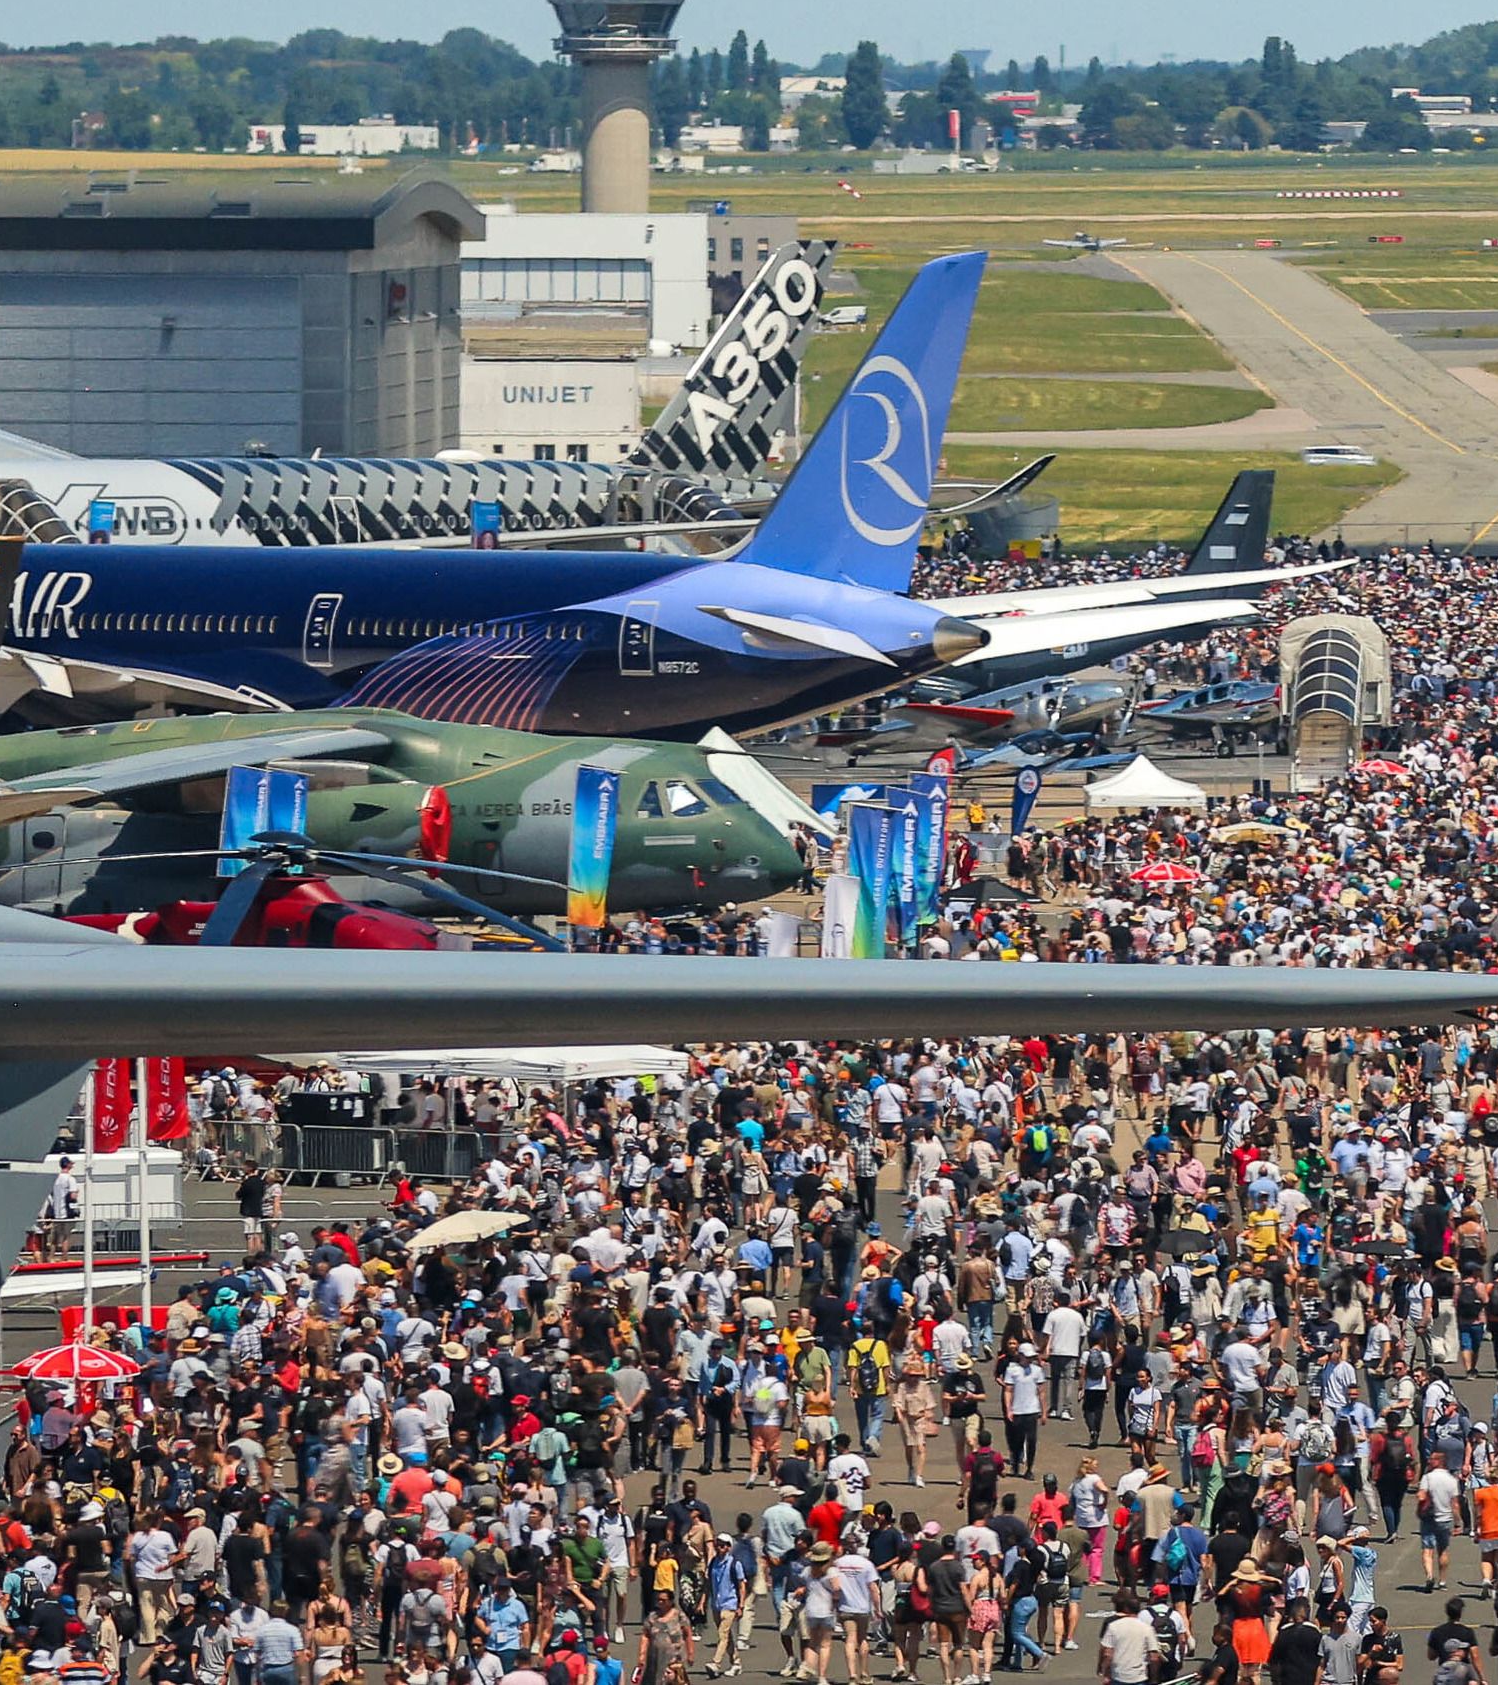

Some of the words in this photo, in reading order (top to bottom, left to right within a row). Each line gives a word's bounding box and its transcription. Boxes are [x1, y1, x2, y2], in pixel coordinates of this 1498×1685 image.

[503, 386, 593, 404] UNIJET
[687, 259, 816, 455] A350
[593, 792, 610, 859] EMBRAER
[902, 818, 916, 903] EMBRAER
[927, 802, 943, 883] EMBRAER
